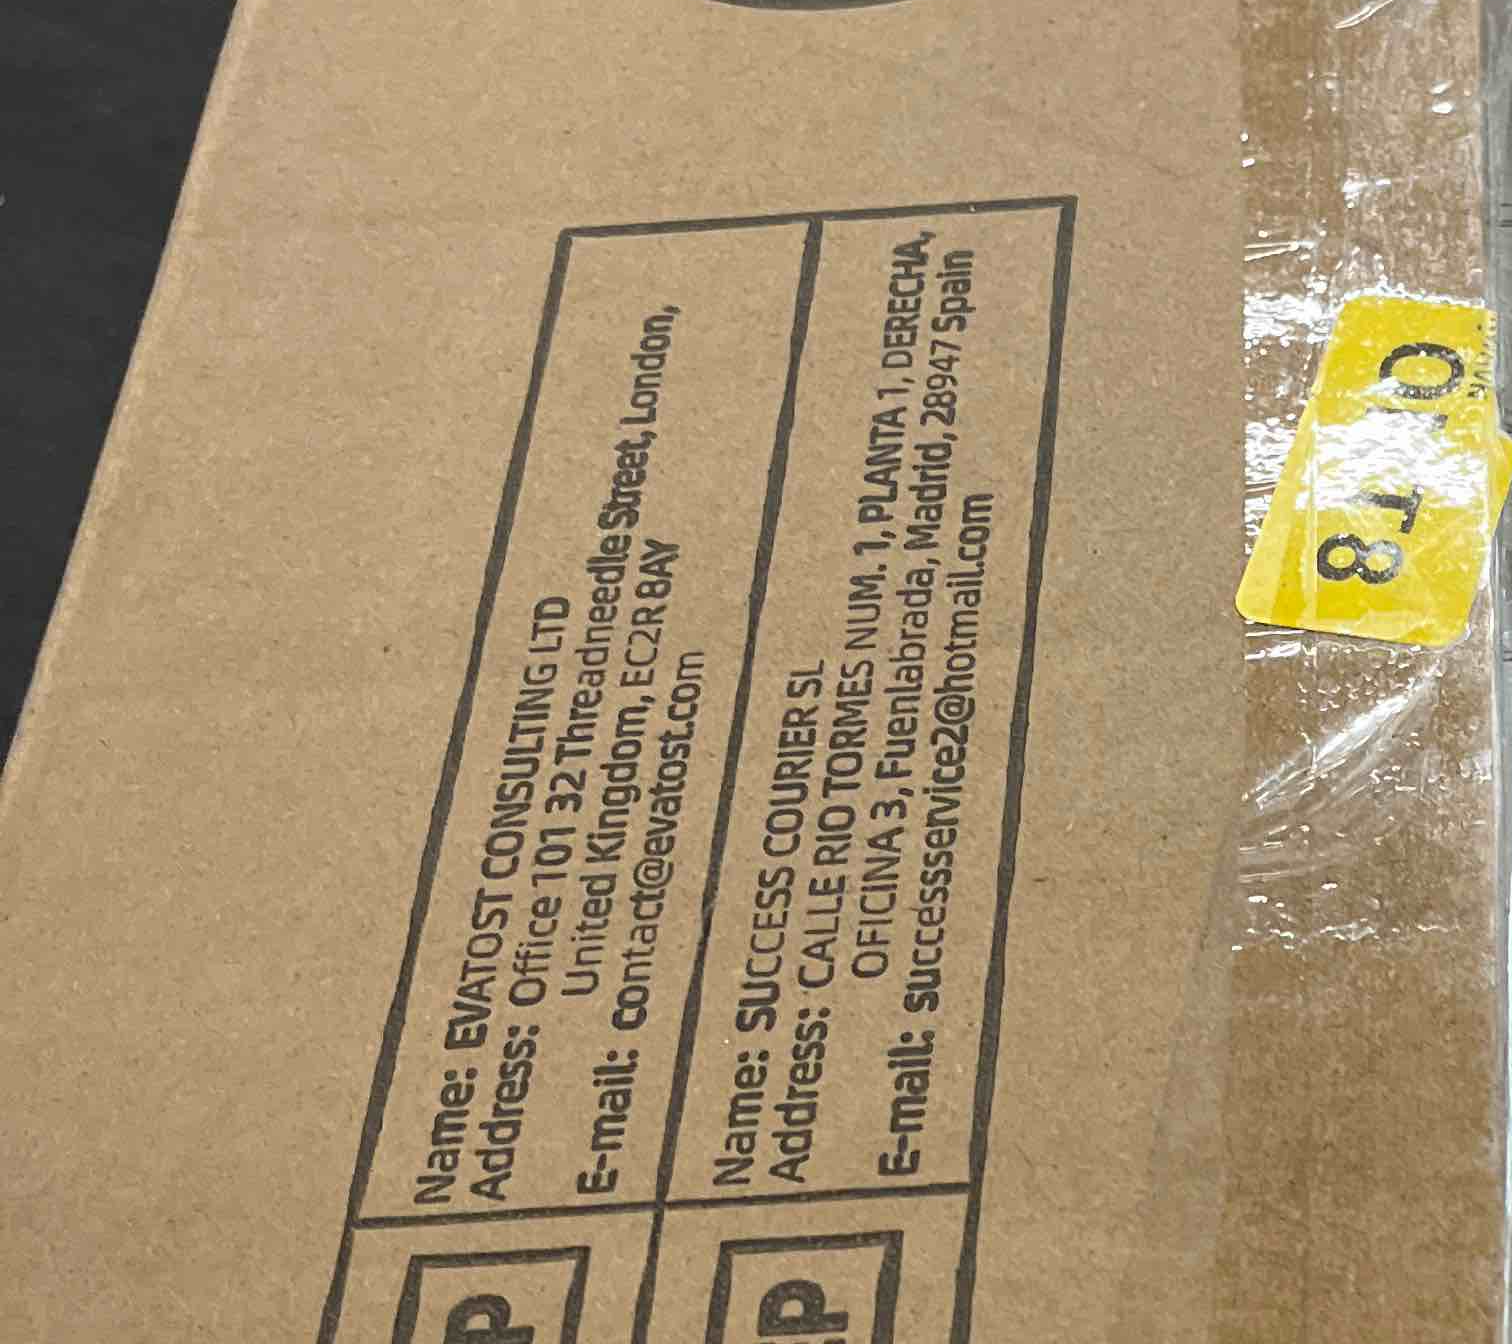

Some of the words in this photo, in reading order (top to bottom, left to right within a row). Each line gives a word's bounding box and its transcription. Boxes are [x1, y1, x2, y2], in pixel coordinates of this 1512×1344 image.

[880, 230, 937, 369] DERECHA,
[929, 249, 975, 333] Spain
[618, 304, 680, 425] London,
[875, 376, 915, 401] 1,
[918, 338, 962, 427] 28947
[595, 429, 657, 530] Street,
[856, 405, 908, 524] PLANTA
[902, 431, 958, 551] Madrid,
[633, 537, 680, 599] 8AY
[851, 529, 897, 556] 1,
[527, 595, 571, 653] LTD
[552, 533, 633, 766] Threadneedle
[618, 603, 668, 687] EC2R
[843, 562, 888, 650] NUM.
[785, 658, 825, 699] SL
[821, 658, 875, 799] TORMES
[873, 557, 942, 780] Fuenlabrada,
[479, 662, 558, 880] CONSULTING
[543, 767, 587, 814] 32
[583, 694, 656, 864] Kingdom,
[761, 704, 820, 857] COURIER
[868, 786, 915, 820] 3,
[901, 492, 995, 1014] successservice2@hotmail.com
[530, 825, 577, 889] 101
[811, 804, 856, 866] RIO
[507, 895, 563, 1007] Office
[559, 872, 617, 996] United
[574, 1048, 640, 1195] E-mail:
[610, 650, 705, 1031] contact@evatost.com
[734, 865, 796, 1033] SUCCESS
[796, 873, 846, 989] CALLE
[849, 825, 905, 979] OFICINA
[442, 886, 513, 1051] EVATOST
[412, 1066, 478, 1205] Name:
[468, 1024, 541, 1202] Address:
[711, 1048, 770, 1187] Name:
[767, 1005, 831, 1184] Address:
[876, 1029, 936, 1177] E-mail:
